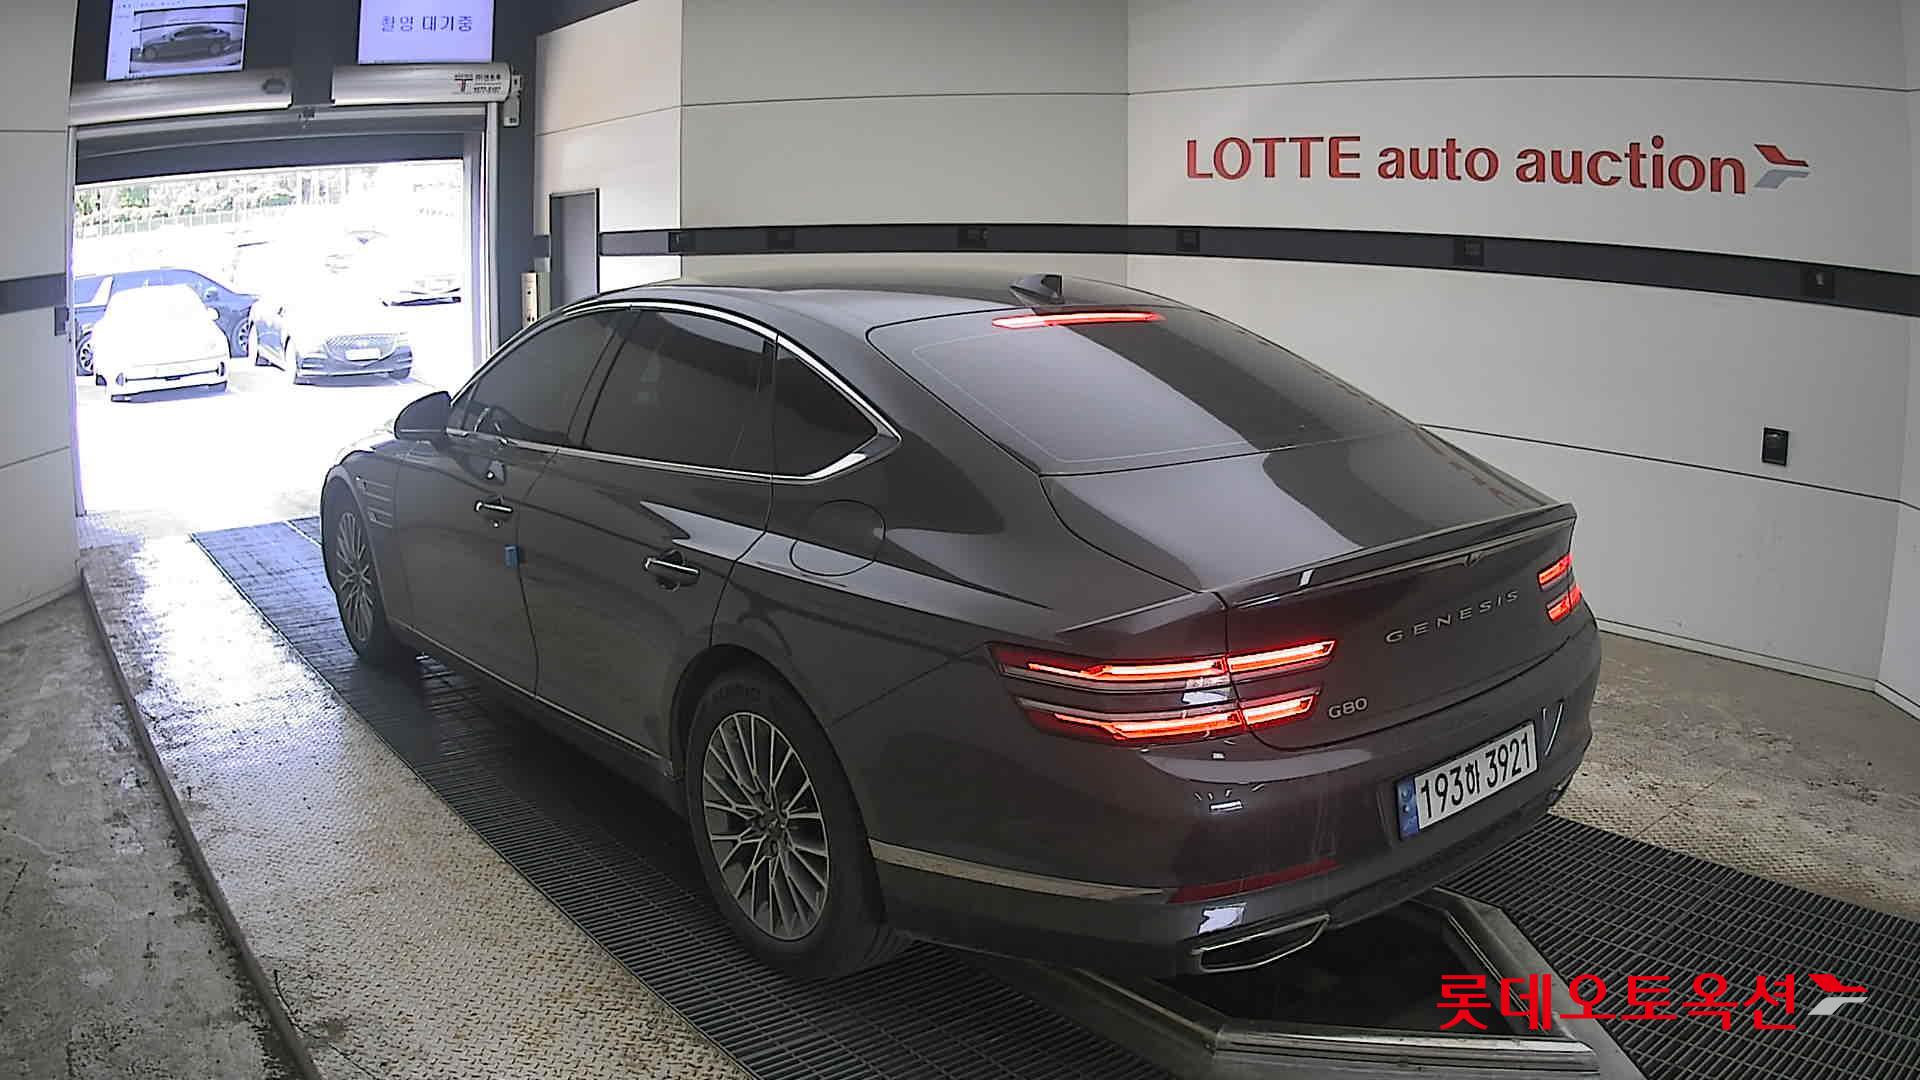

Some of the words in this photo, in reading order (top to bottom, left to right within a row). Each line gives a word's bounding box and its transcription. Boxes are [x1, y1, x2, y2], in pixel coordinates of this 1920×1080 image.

[422, 15, 473, 32] 대기중
[1186, 135, 1361, 179] LOTTE
[1377, 138, 1499, 182] auto
[1515, 135, 1746, 194] auction
[1385, 589, 1519, 643] GENESIS
[1328, 697, 1368, 719] G80
[1420, 762, 1480, 818] 193하
[1485, 732, 1530, 788] 3921
